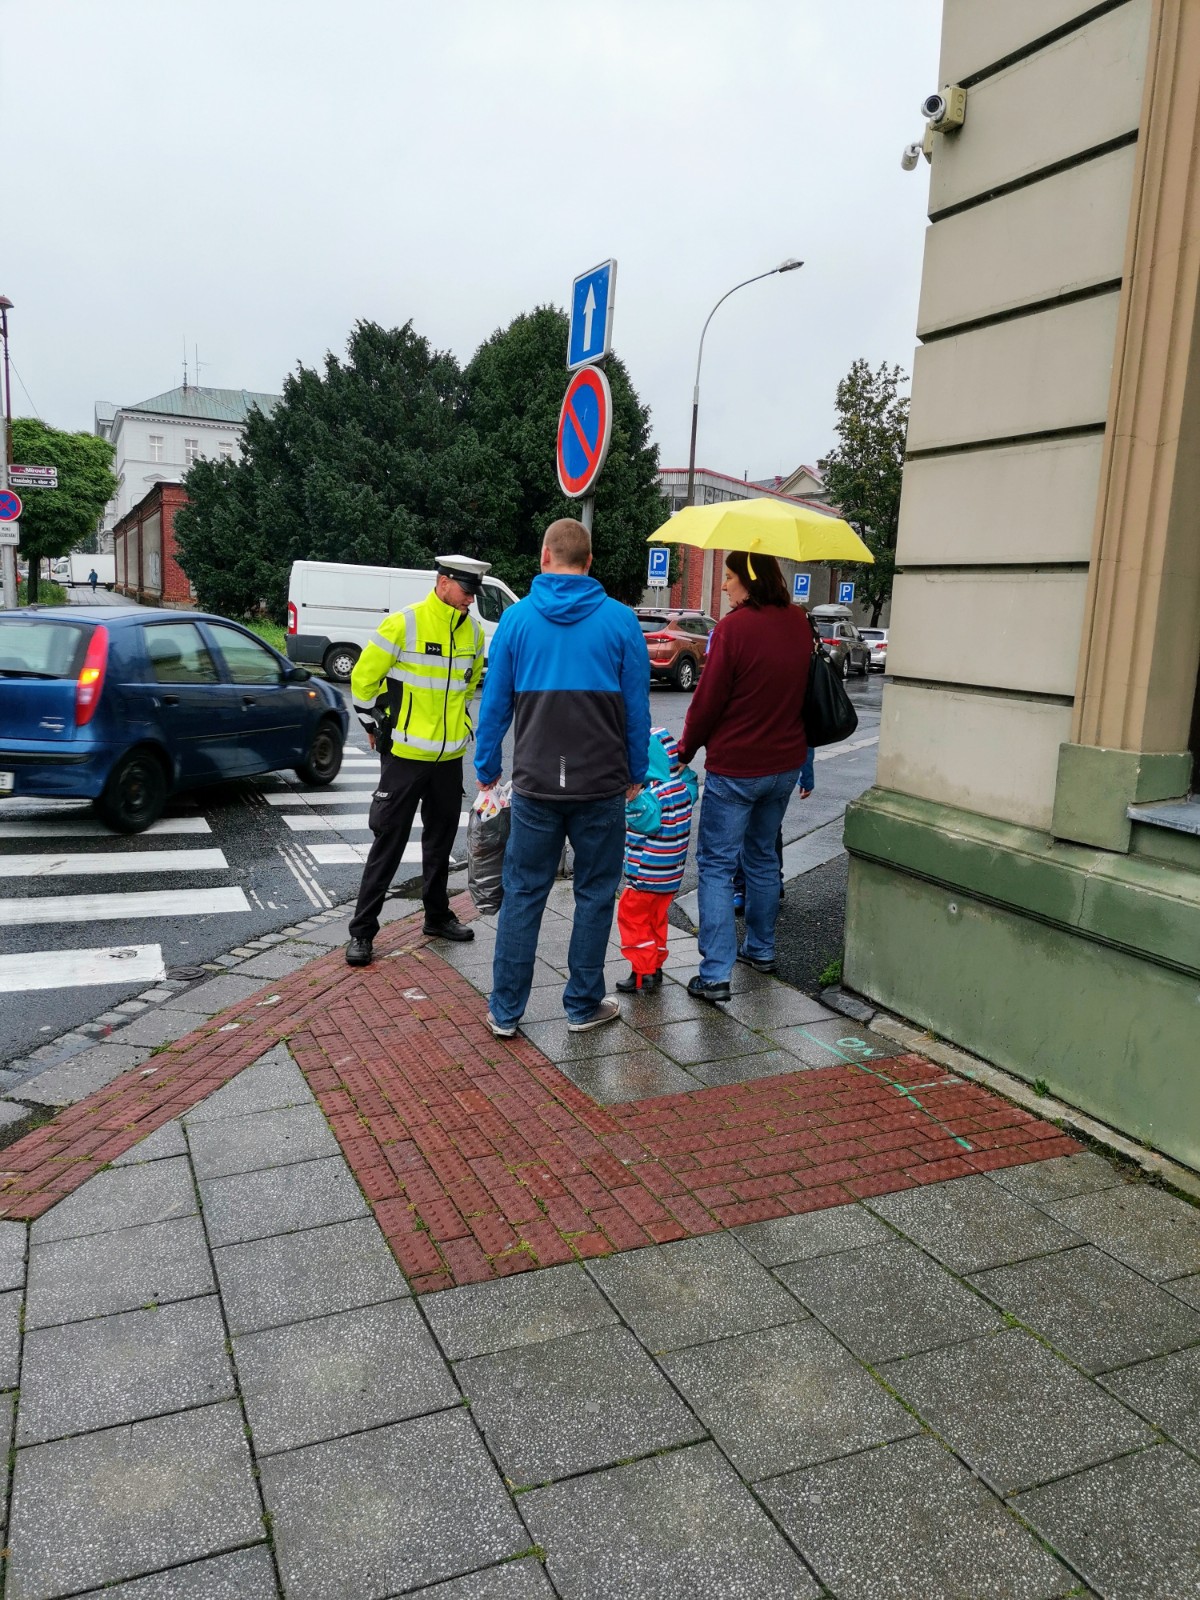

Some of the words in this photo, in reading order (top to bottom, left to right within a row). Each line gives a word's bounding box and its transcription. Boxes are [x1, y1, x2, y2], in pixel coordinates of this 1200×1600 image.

[653, 552, 665, 569] P
[797, 576, 807, 590] P
[842, 585, 851, 597] P
